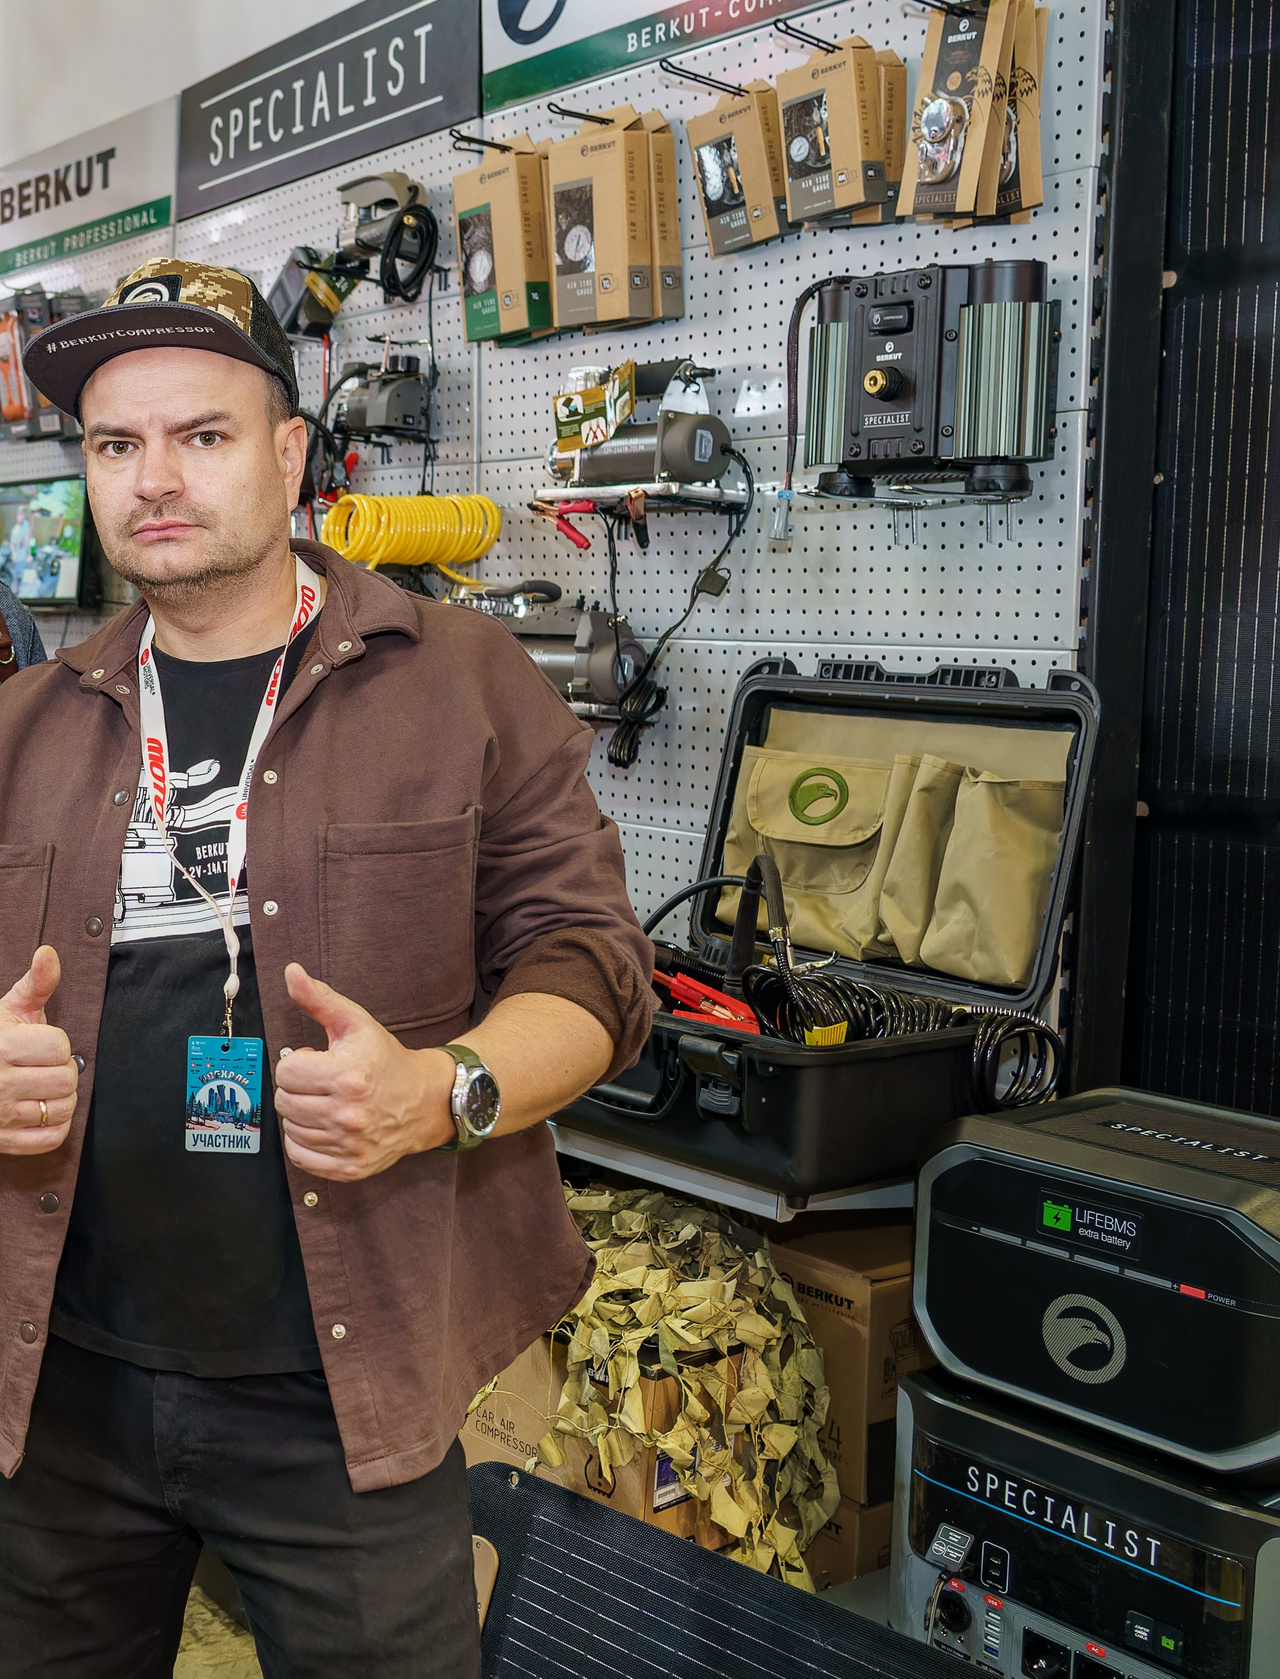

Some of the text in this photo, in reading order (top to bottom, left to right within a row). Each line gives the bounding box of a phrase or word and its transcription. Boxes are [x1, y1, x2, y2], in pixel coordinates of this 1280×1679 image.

[948, 31, 977, 43] BERKUT
[209, 23, 432, 166] SPECIALIST
[0, 147, 116, 225] BERKUT
[14, 208, 158, 268] BERKUT PROFESSIONAL
[876, 353, 903, 362] BERKUT
[864, 414, 910, 426] SPECIALIST
[192, 1133, 251, 1149] УЧАСТНИК
[1110, 1122, 1270, 1162] SPECIALIST
[1075, 1207, 1136, 1237] LIFEBMS
[1078, 1227, 1131, 1250] extra battery
[797, 1282, 855, 1310] BERKUT
[1208, 1293, 1237, 1307] POWER
[475, 1419, 538, 1458] COMPRESSOR
[500, 1417, 515, 1434] AIR
[967, 1466, 1162, 1566] SPECIALIST
